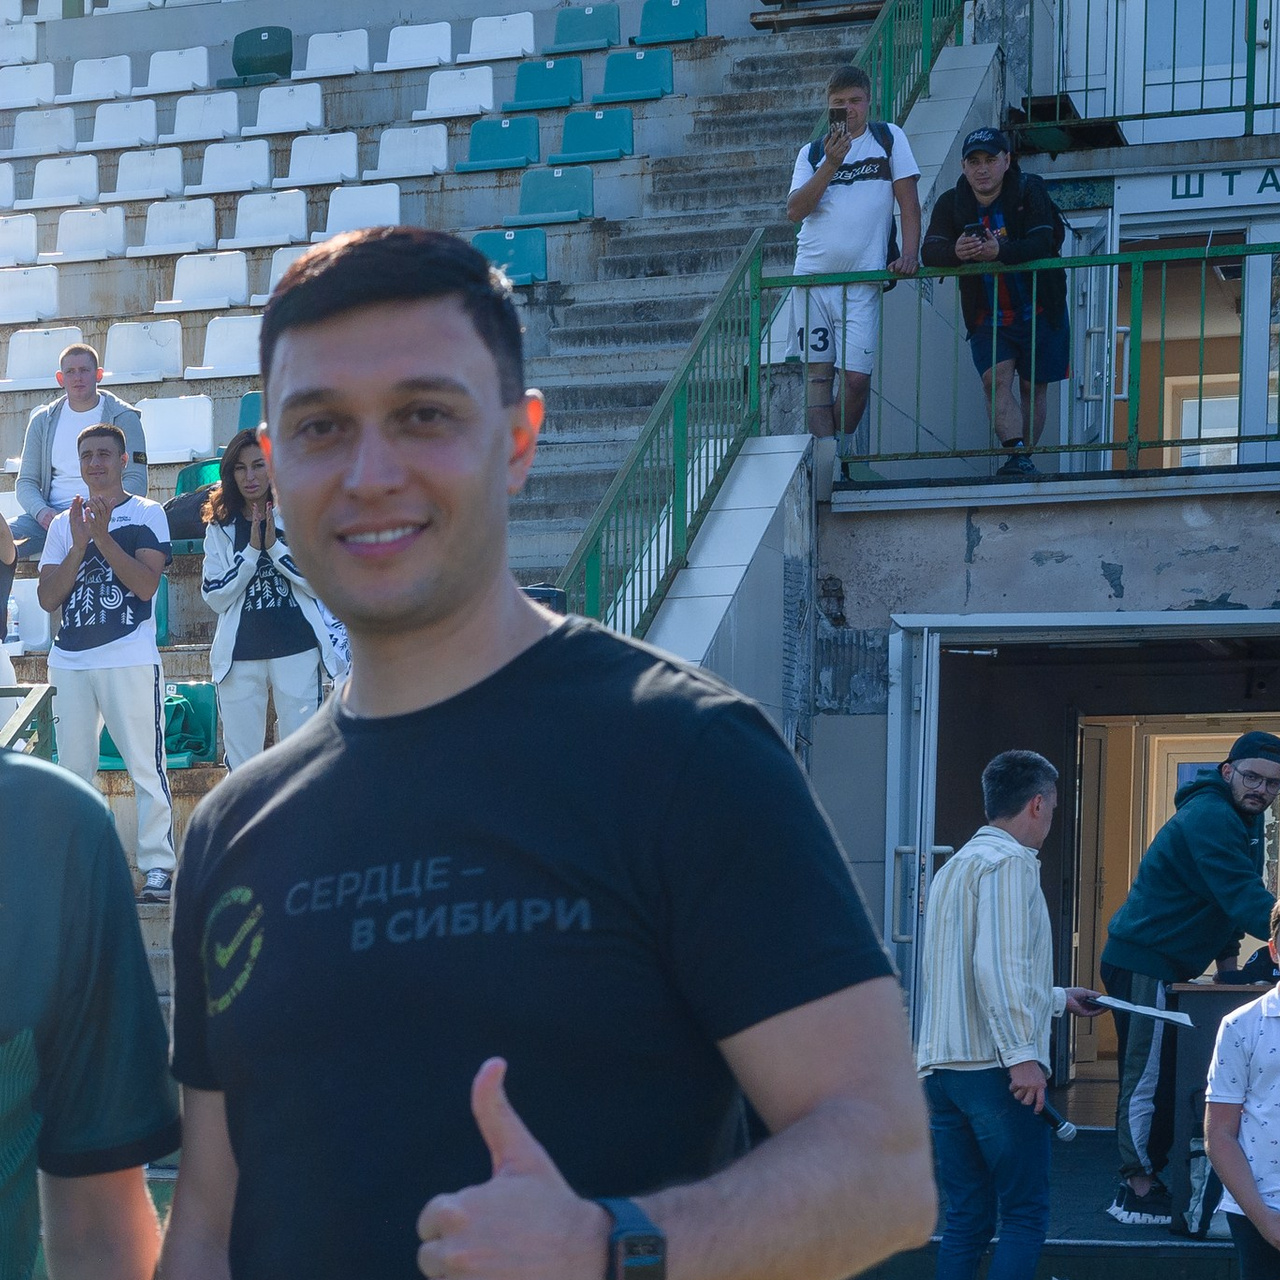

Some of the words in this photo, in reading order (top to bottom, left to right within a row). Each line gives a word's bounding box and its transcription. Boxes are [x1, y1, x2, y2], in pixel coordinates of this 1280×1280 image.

[797, 327, 830, 352] 13
[284, 856, 453, 916] СЕРДЦЕ
[350, 916, 377, 951] В
[385, 897, 592, 944] СИБИРИ
